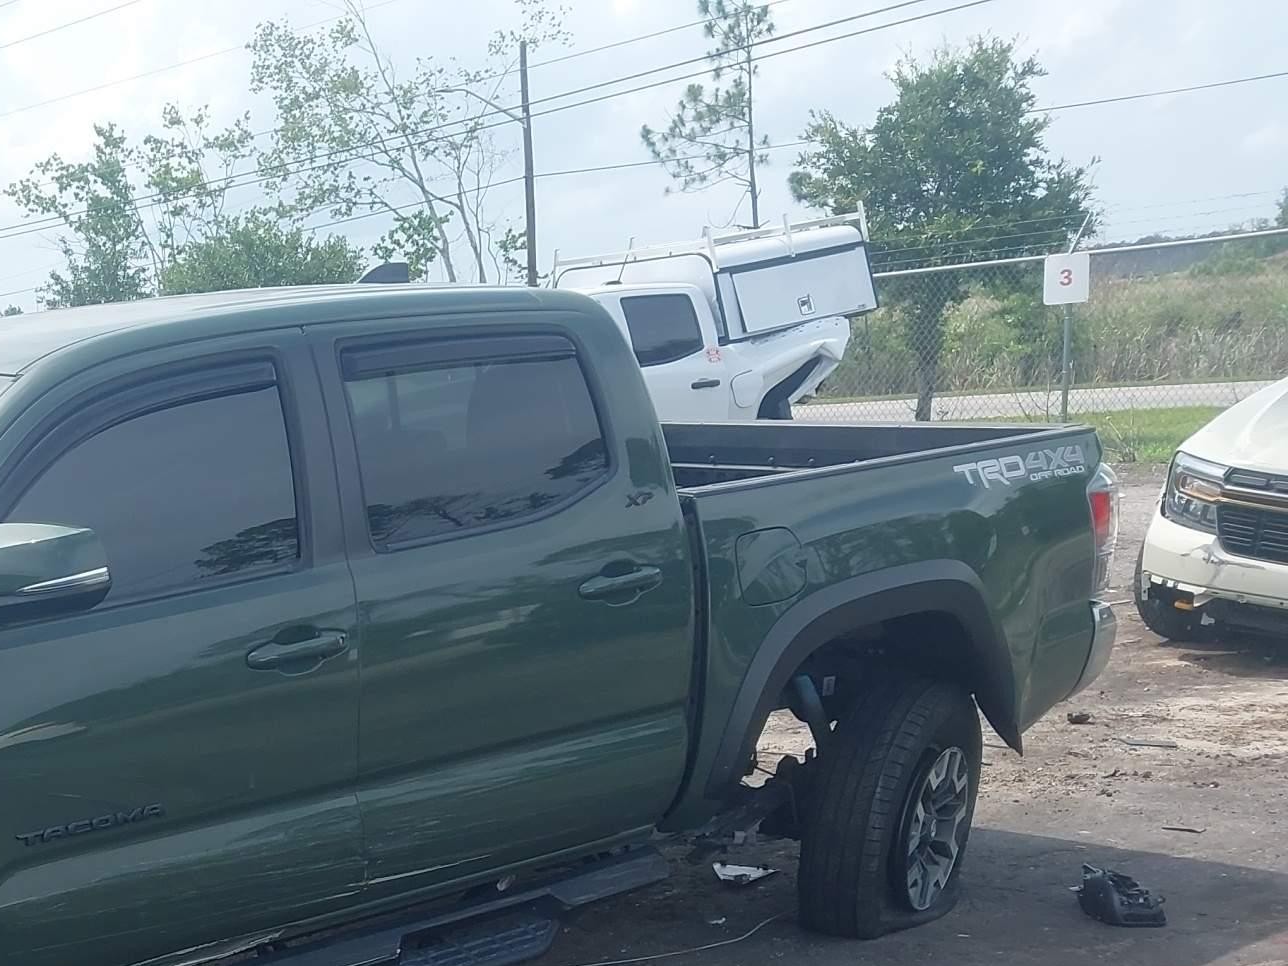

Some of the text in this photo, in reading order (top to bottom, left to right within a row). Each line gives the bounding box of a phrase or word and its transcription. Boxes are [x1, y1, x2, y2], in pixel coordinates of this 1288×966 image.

[1059, 268, 1073, 286] 3
[952, 455, 1026, 489] TRD
[1030, 465, 1085, 482] OFF ROAD
[15, 803, 163, 847] TACOMA
